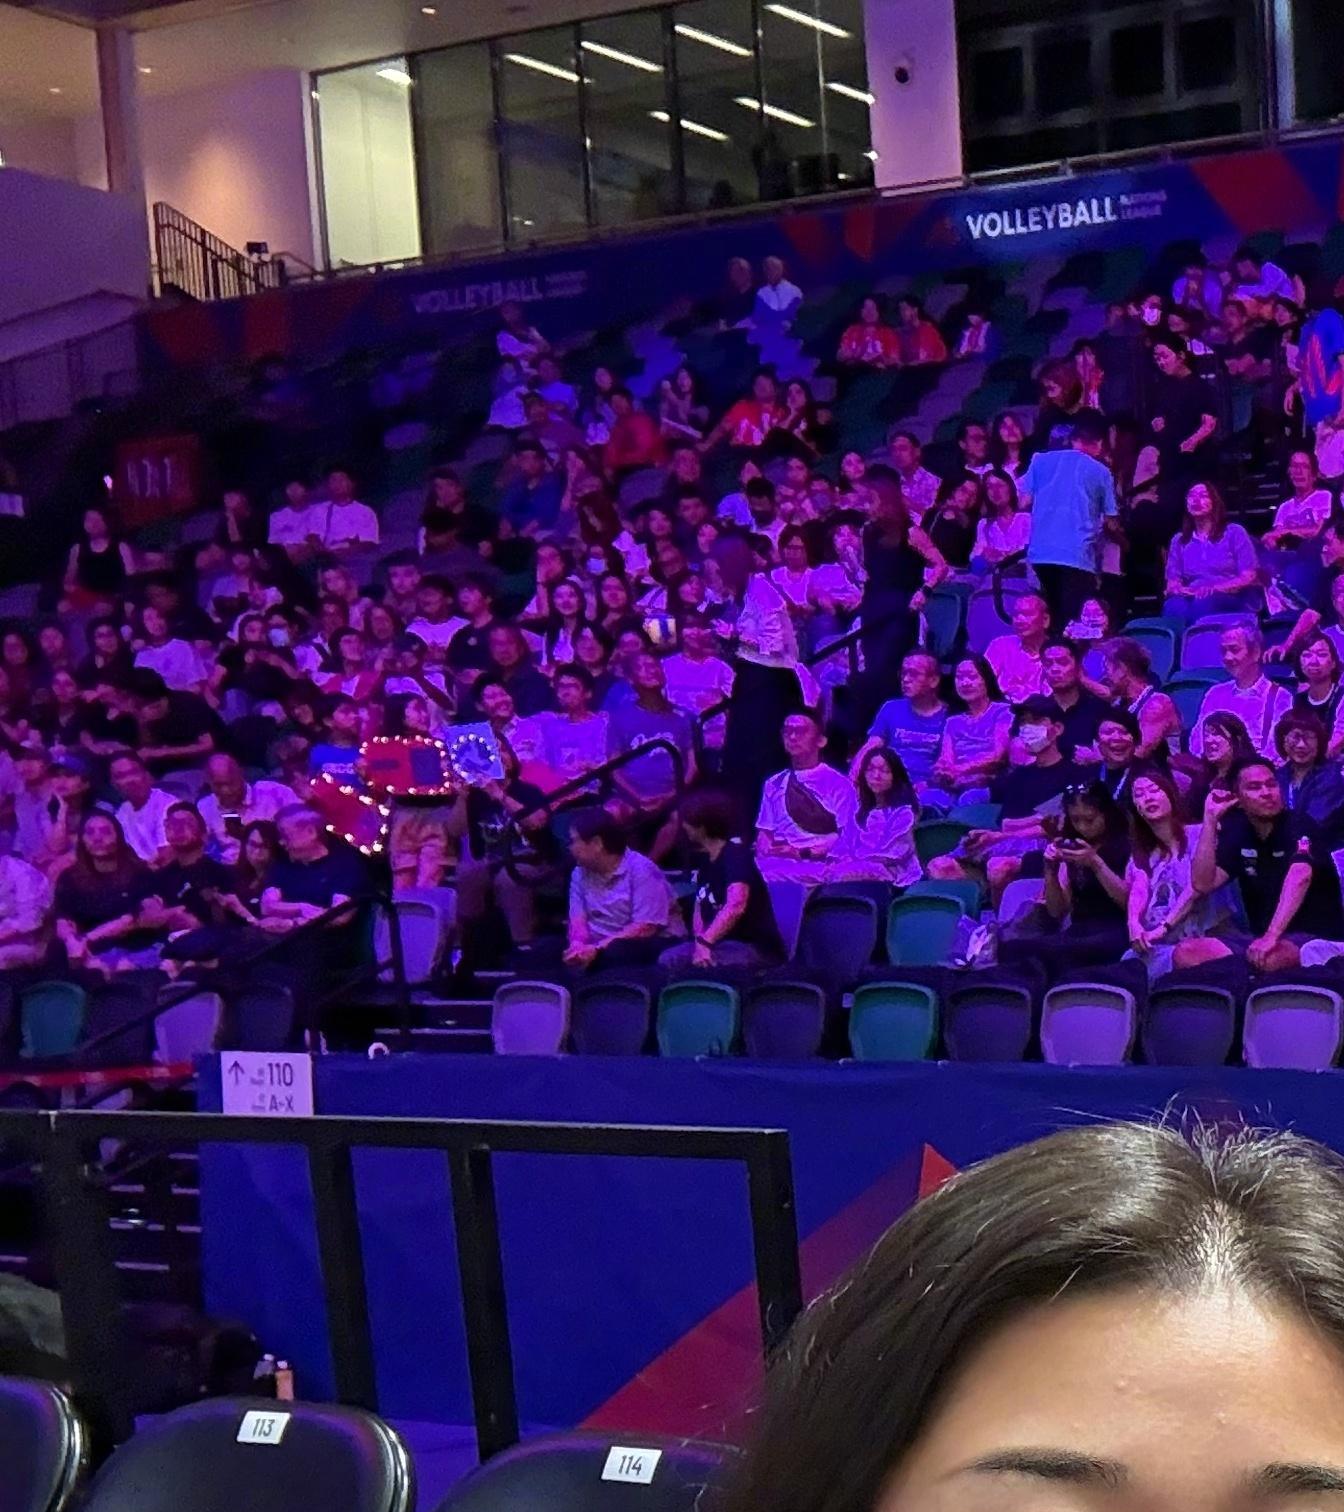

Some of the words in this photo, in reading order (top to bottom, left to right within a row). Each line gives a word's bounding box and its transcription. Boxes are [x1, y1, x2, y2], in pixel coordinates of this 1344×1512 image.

[966, 196, 1117, 240] VOLLEYBALL
[268, 1062, 294, 1087] 110
[252, 1418, 276, 1438] 113
[618, 1454, 643, 1476] 114
